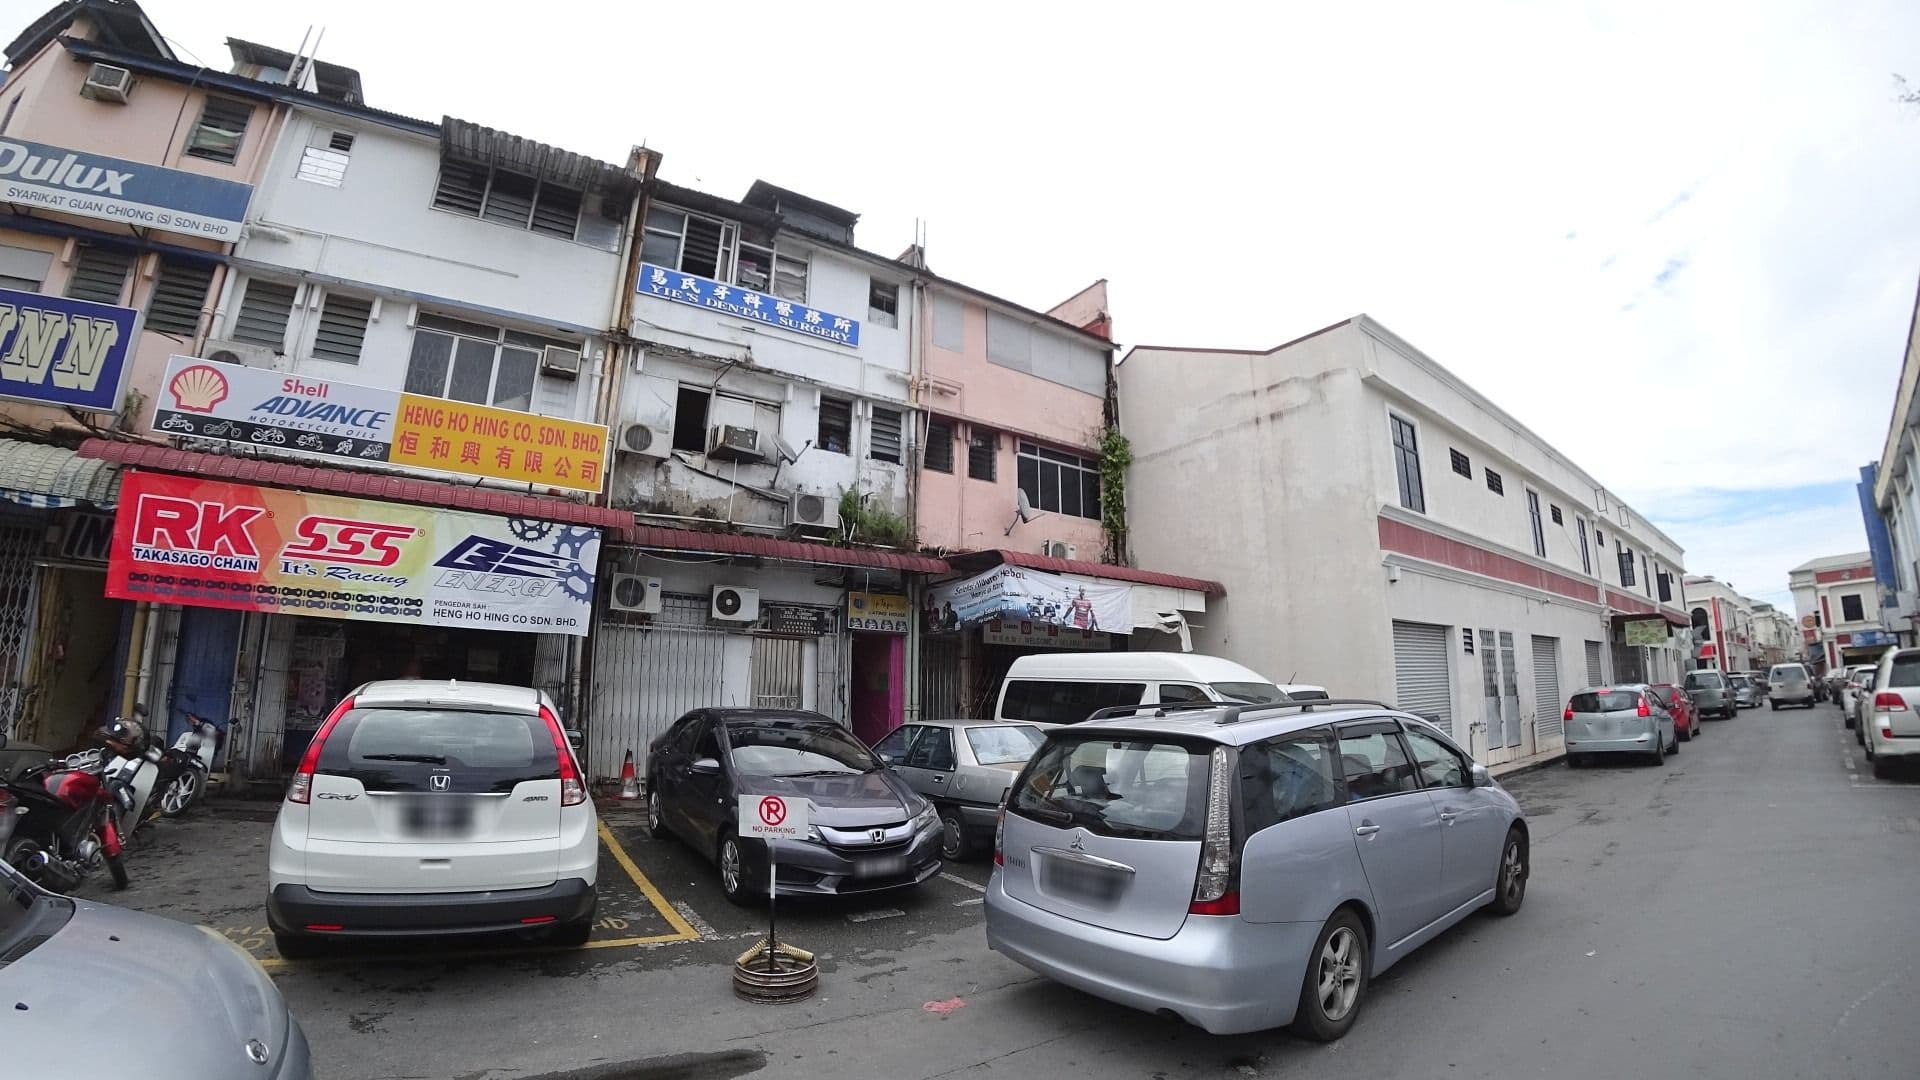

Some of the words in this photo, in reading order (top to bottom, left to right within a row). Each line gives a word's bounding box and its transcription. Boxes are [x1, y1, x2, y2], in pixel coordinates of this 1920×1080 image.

[0, 141, 134, 195] Dulux
[7, 187, 66, 206] SYARIKAT
[69, 199, 102, 212] GUAN
[106, 204, 154, 221] CHIONG
[157, 214, 171, 225] (S)
[174, 217, 201, 230] SDN
[203, 223, 228, 235] BHD
[649, 284, 699, 304] YIE'S
[706, 298, 773, 322] DENTAL
[779, 316, 851, 342] SURGERY
[282, 379, 329, 398] Shell
[248, 416, 338, 434] MOTORCYCLE
[346, 429, 377, 439] OILS
[252, 396, 391, 430] ADVANCE
[404, 404, 444, 428] HENG
[447, 411, 469, 433] HO
[473, 415, 509, 438] HING
[513, 422, 534, 443] CO.
[538, 426, 568, 448] SDN.
[572, 432, 601, 453] BHD.
[399, 430, 599, 484] 恒和興有限公司
[132, 493, 266, 559] RK
[282, 516, 416, 567] SSS
[133, 548, 209, 566] TAKASAGO
[215, 557, 258, 571] CHAIN
[281, 560, 318, 577] It's
[324, 566, 409, 587] Racing
[433, 608, 463, 618] HENG
[465, 611, 481, 620] HO
[484, 612, 510, 622] HING
[512, 615, 527, 623] CO
[434, 600, 471, 609] PENGEDAR
[752, 825, 763, 833] NO
[764, 826, 796, 834] PARKING
